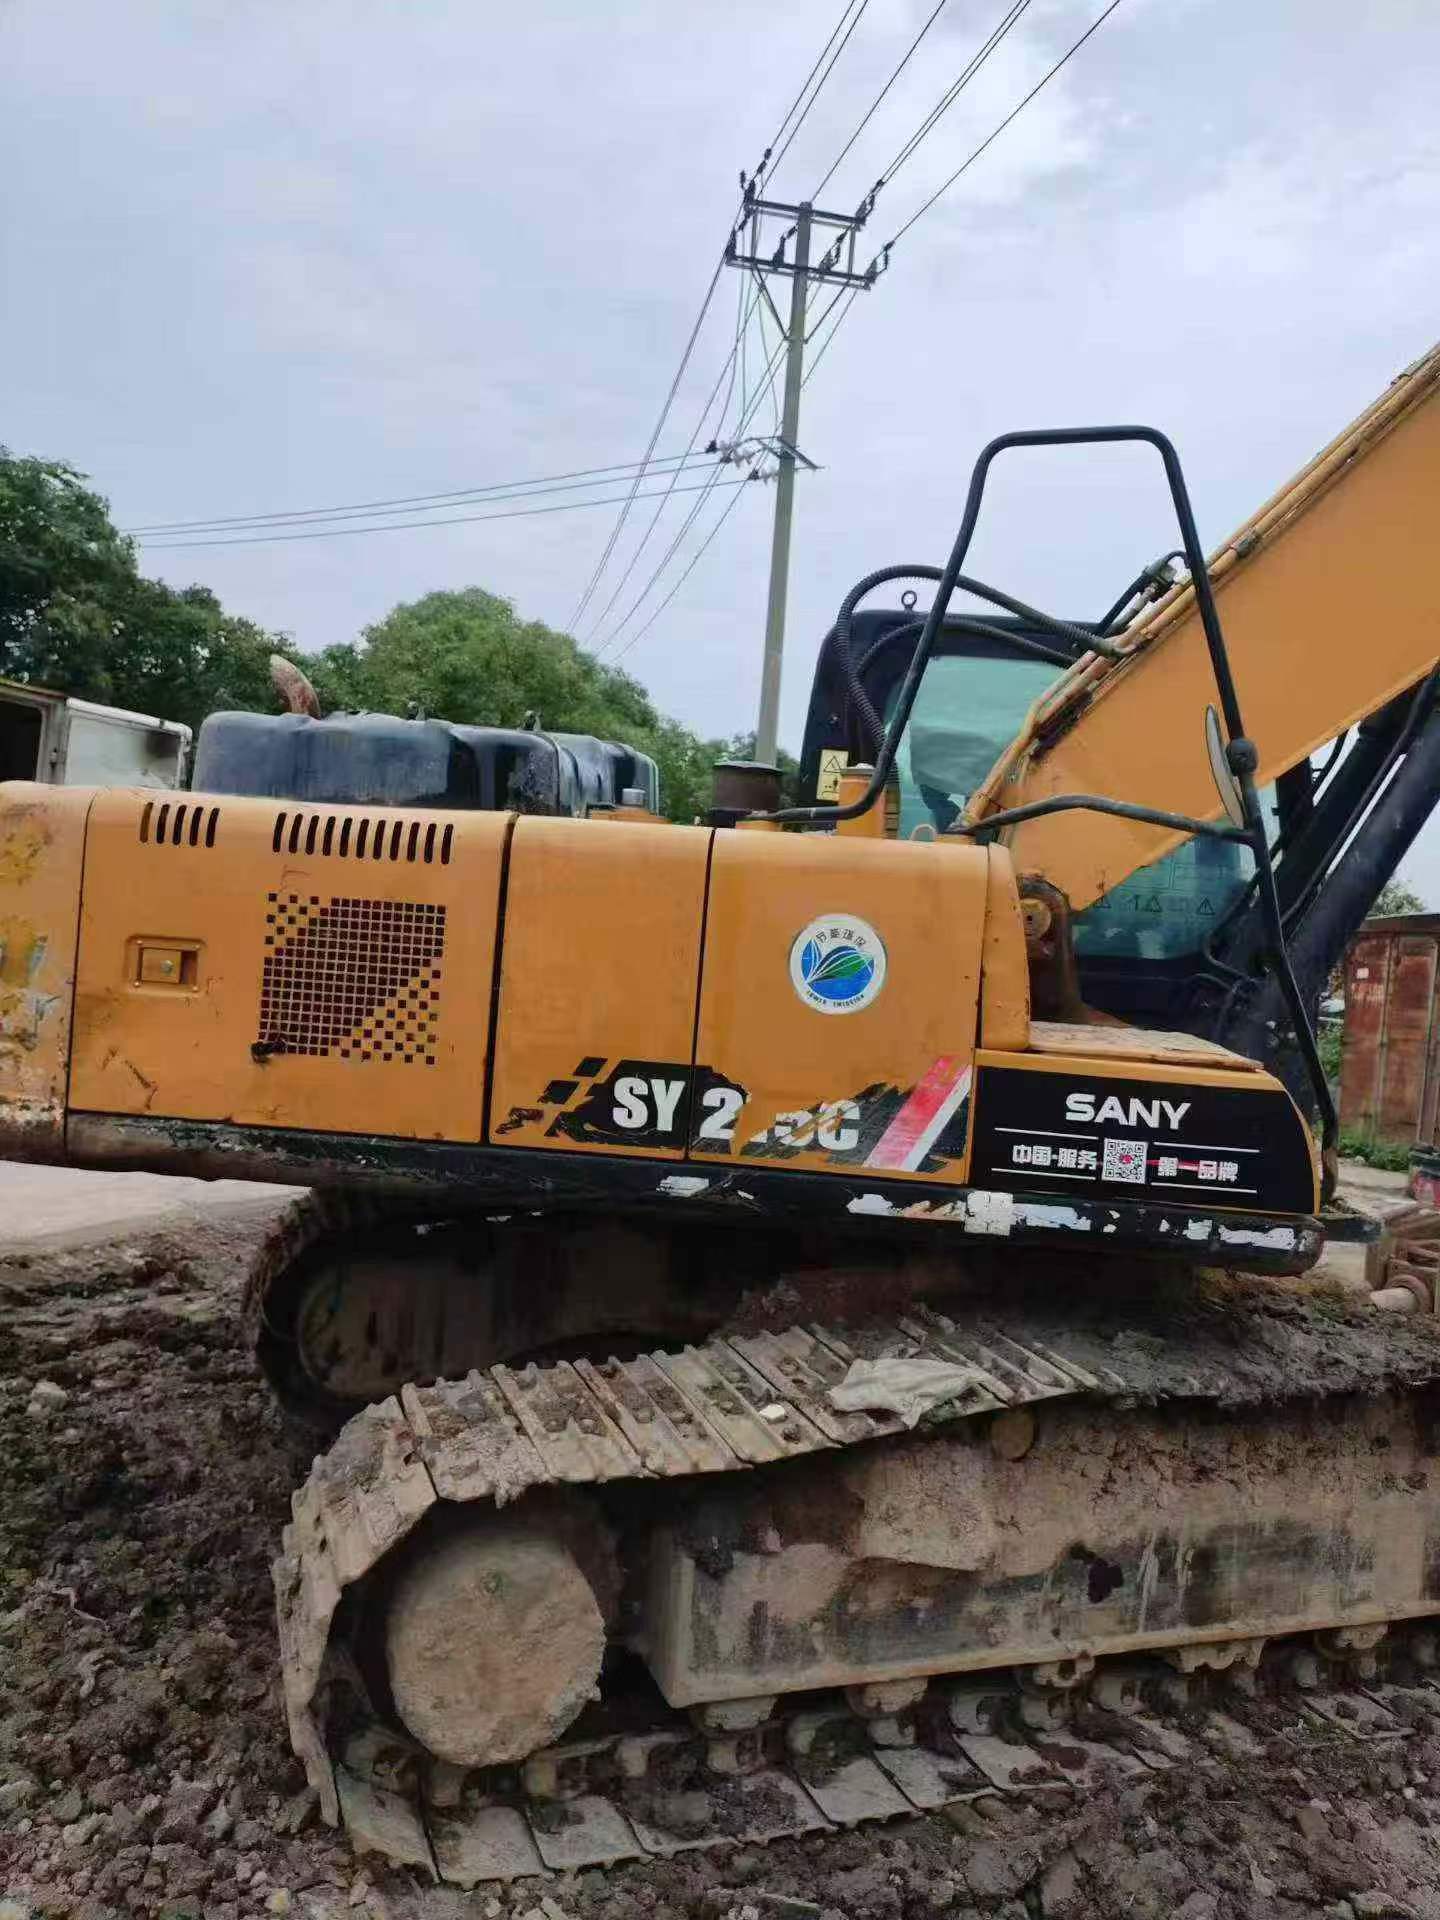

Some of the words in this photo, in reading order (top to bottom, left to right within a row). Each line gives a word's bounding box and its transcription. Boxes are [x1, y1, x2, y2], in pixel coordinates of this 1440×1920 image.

[612, 1077, 686, 1131] SY
[1064, 1092, 1193, 1131] SANY
[1012, 1144, 1098, 1171] 中国·服务
